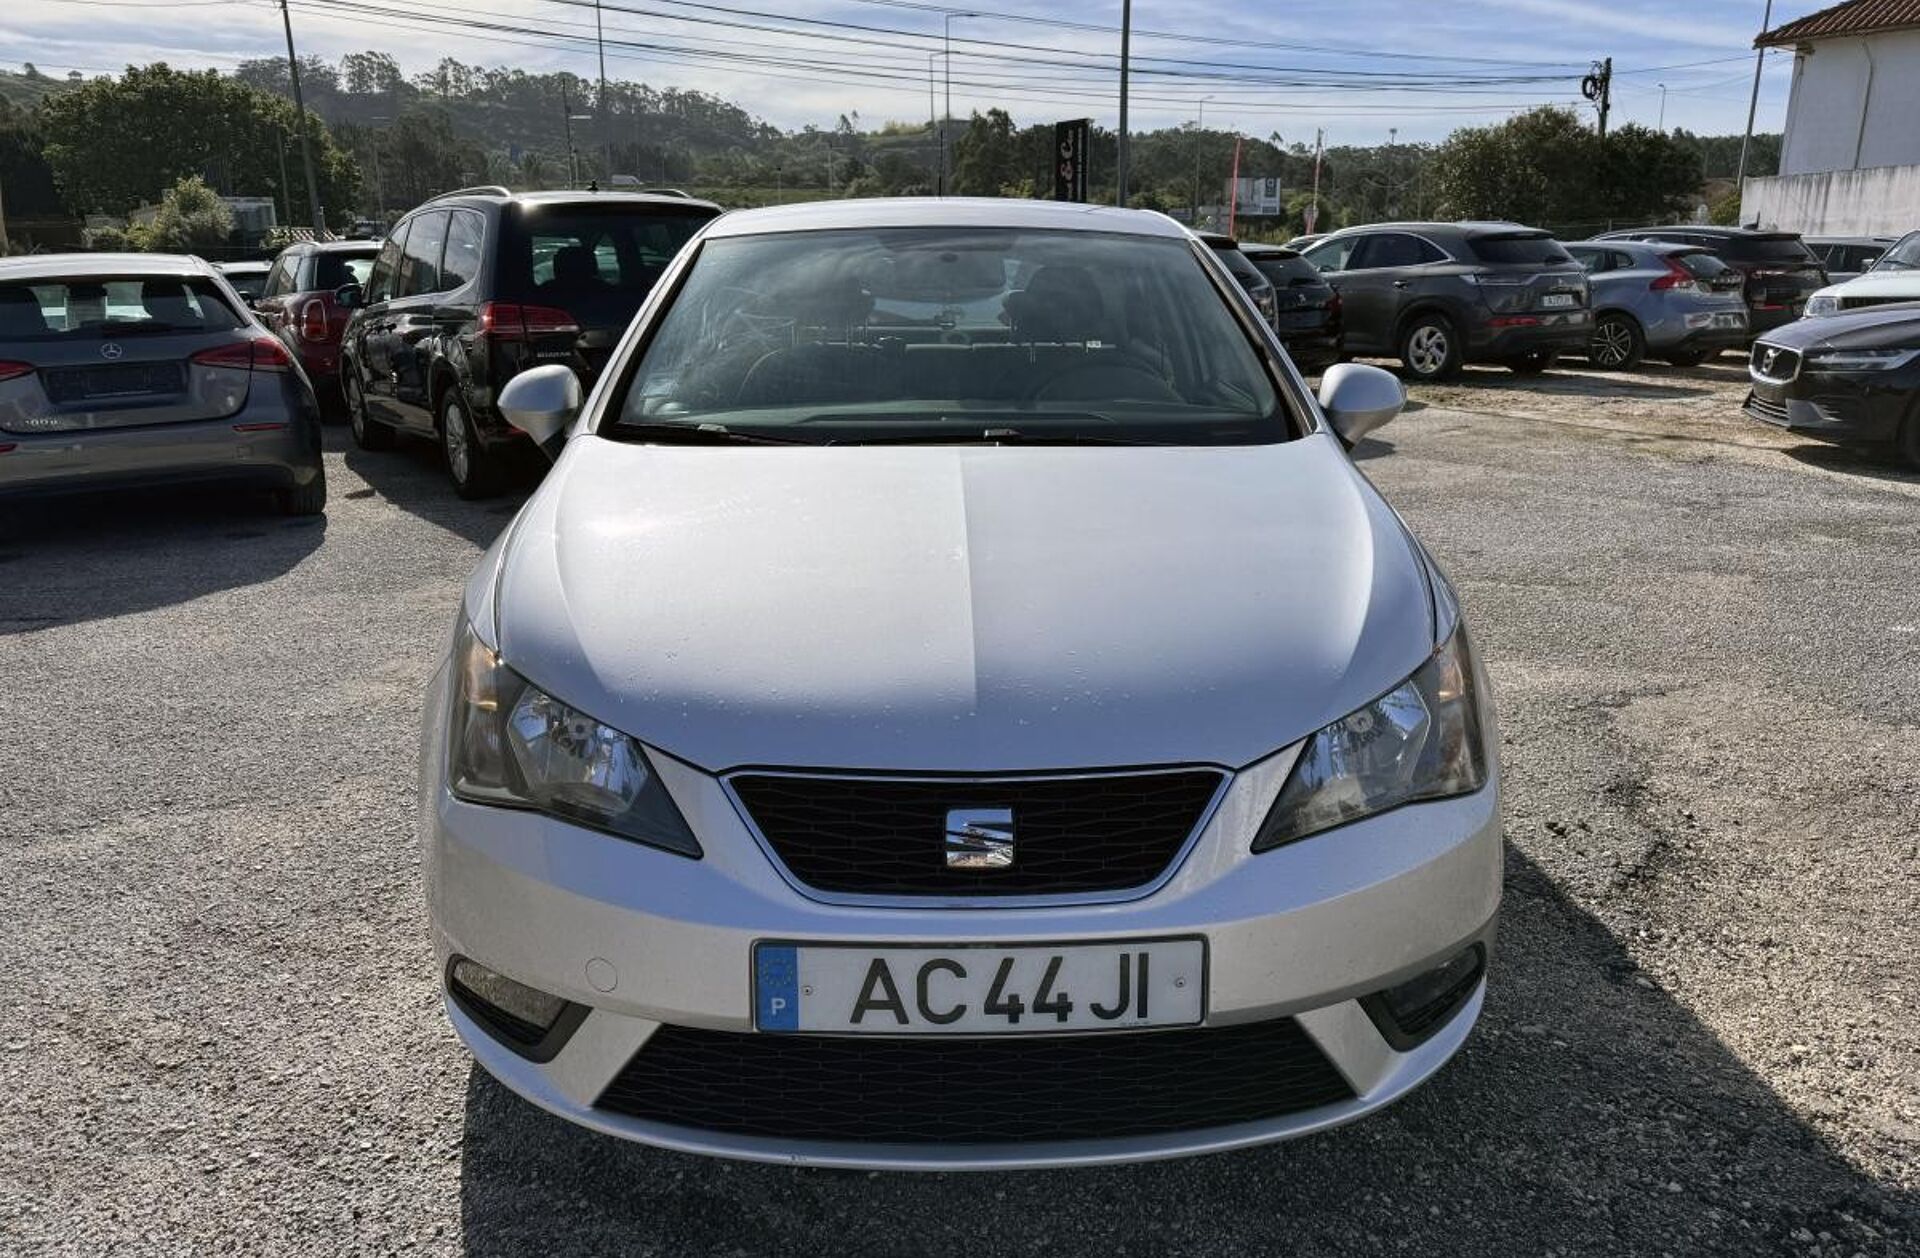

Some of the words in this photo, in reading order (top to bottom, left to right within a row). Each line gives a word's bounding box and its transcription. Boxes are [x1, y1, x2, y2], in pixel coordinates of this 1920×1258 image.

[771, 997, 786, 1016] P
[849, 957, 969, 1025] AC
[983, 955, 1073, 1024] 44
[1089, 952, 1150, 1020] JI
